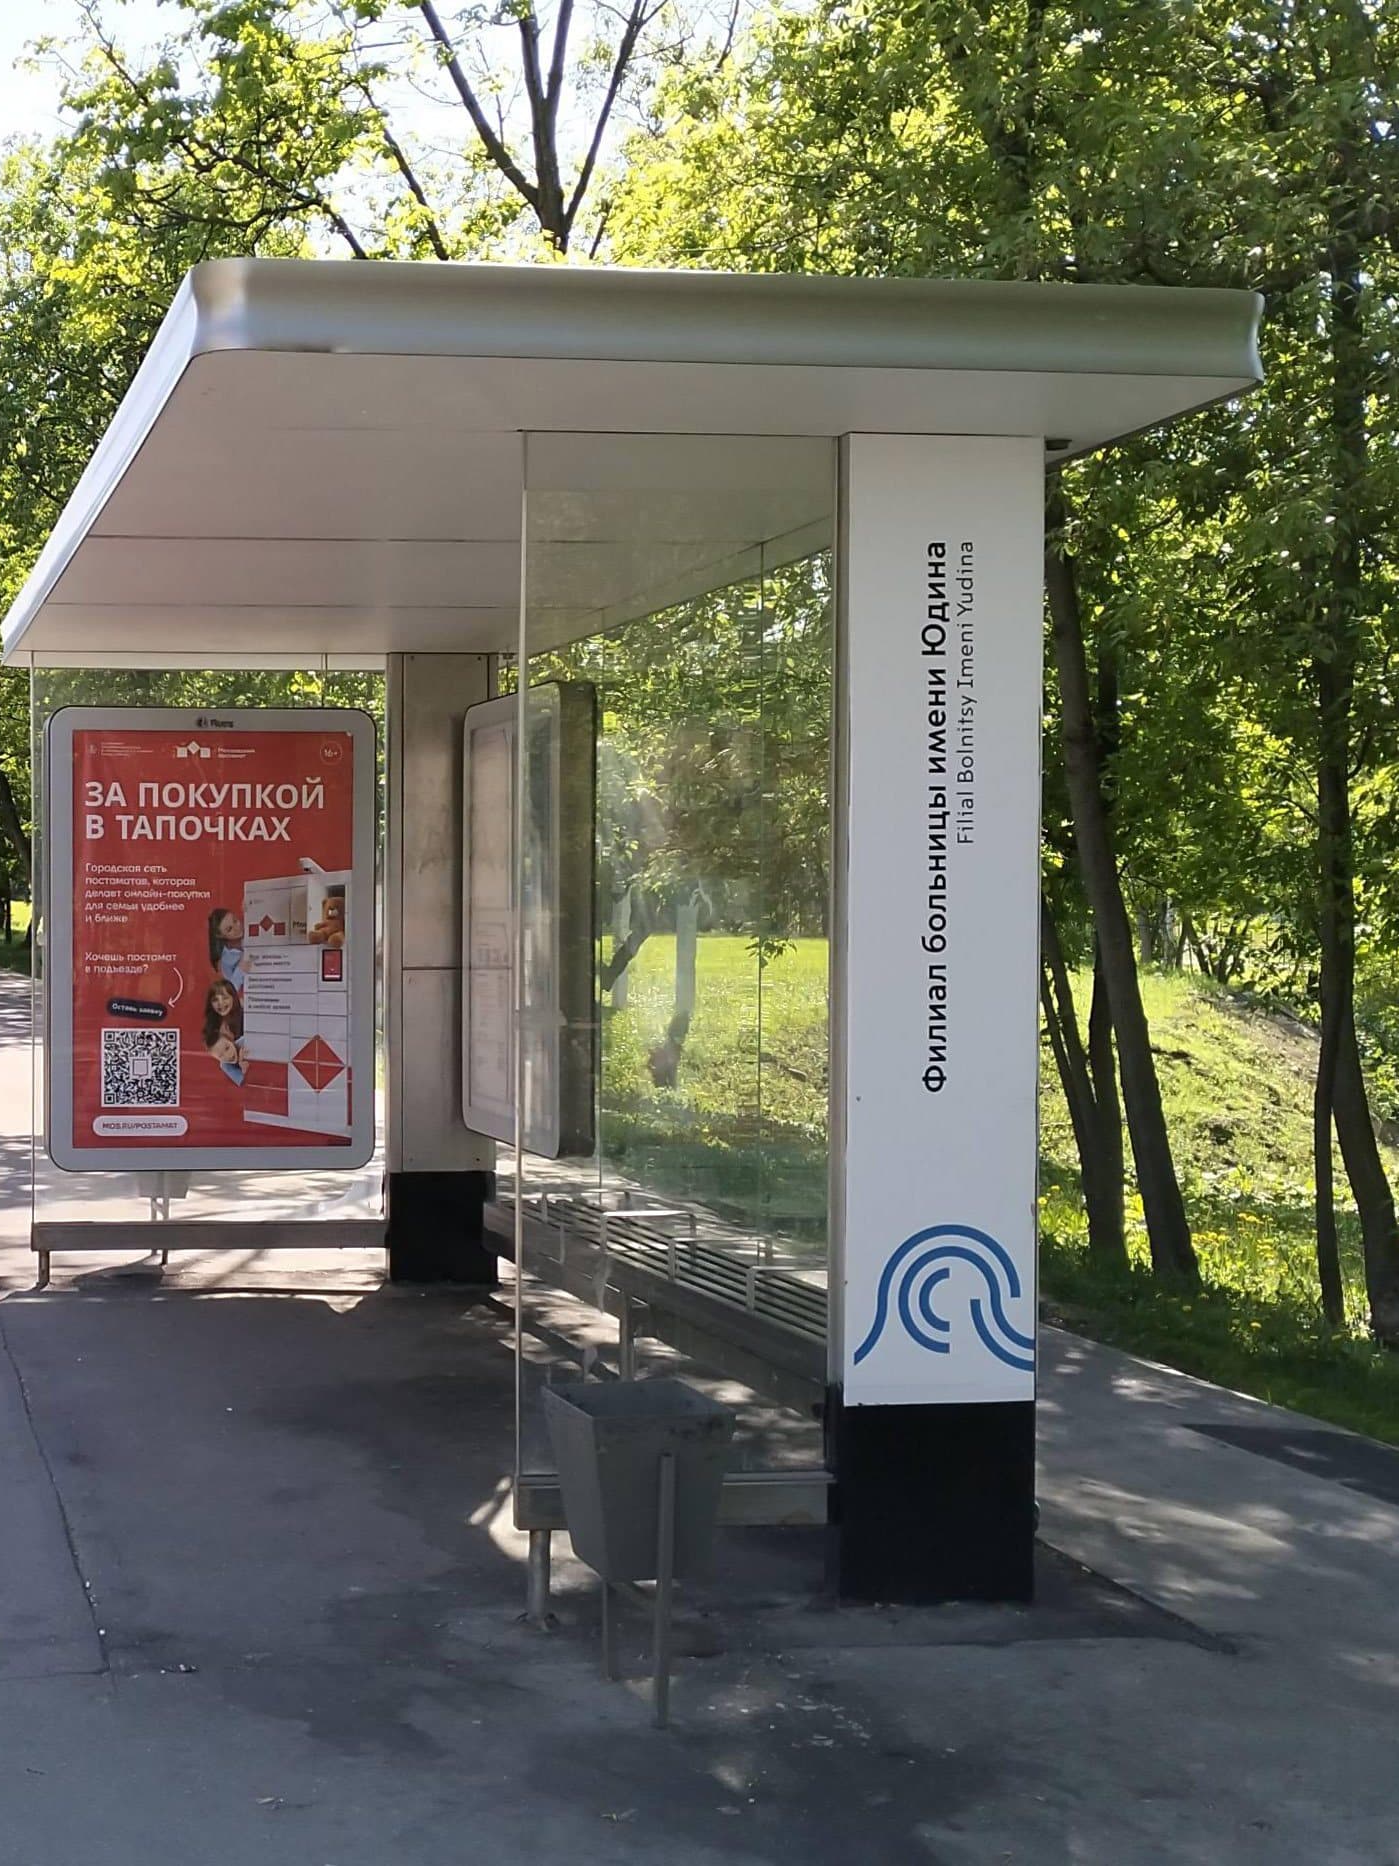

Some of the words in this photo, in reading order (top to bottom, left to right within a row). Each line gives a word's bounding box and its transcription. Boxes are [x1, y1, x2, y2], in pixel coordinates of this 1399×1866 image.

[921, 542, 950, 656] Юдина
[955, 541, 974, 617] Yudina
[956, 623, 974, 688] Imeni
[928, 669, 947, 774] имени
[956, 695, 978, 783] Bolnitsy
[85, 781, 127, 807] ЗА
[139, 776, 324, 809] ПОКУПКОЙ
[85, 816, 105, 840] В
[116, 815, 292, 841] ТАПОЧКАХ
[956, 791, 974, 844] Filial
[85, 862, 141, 874] Городская
[143, 865, 168, 873] сеть
[85, 877, 150, 886] постаматов,
[153, 878, 196, 888] которая
[921, 786, 951, 953] больницы
[85, 890, 121, 898] делает
[124, 888, 211, 899] онлайн-покупки
[85, 902, 104, 911] для
[106, 902, 138, 910] семьи
[141, 902, 185, 912] удобнее
[94, 914, 128, 922] ближе
[85, 952, 124, 961] Хочешь
[922, 964, 947, 1093] Филиал
